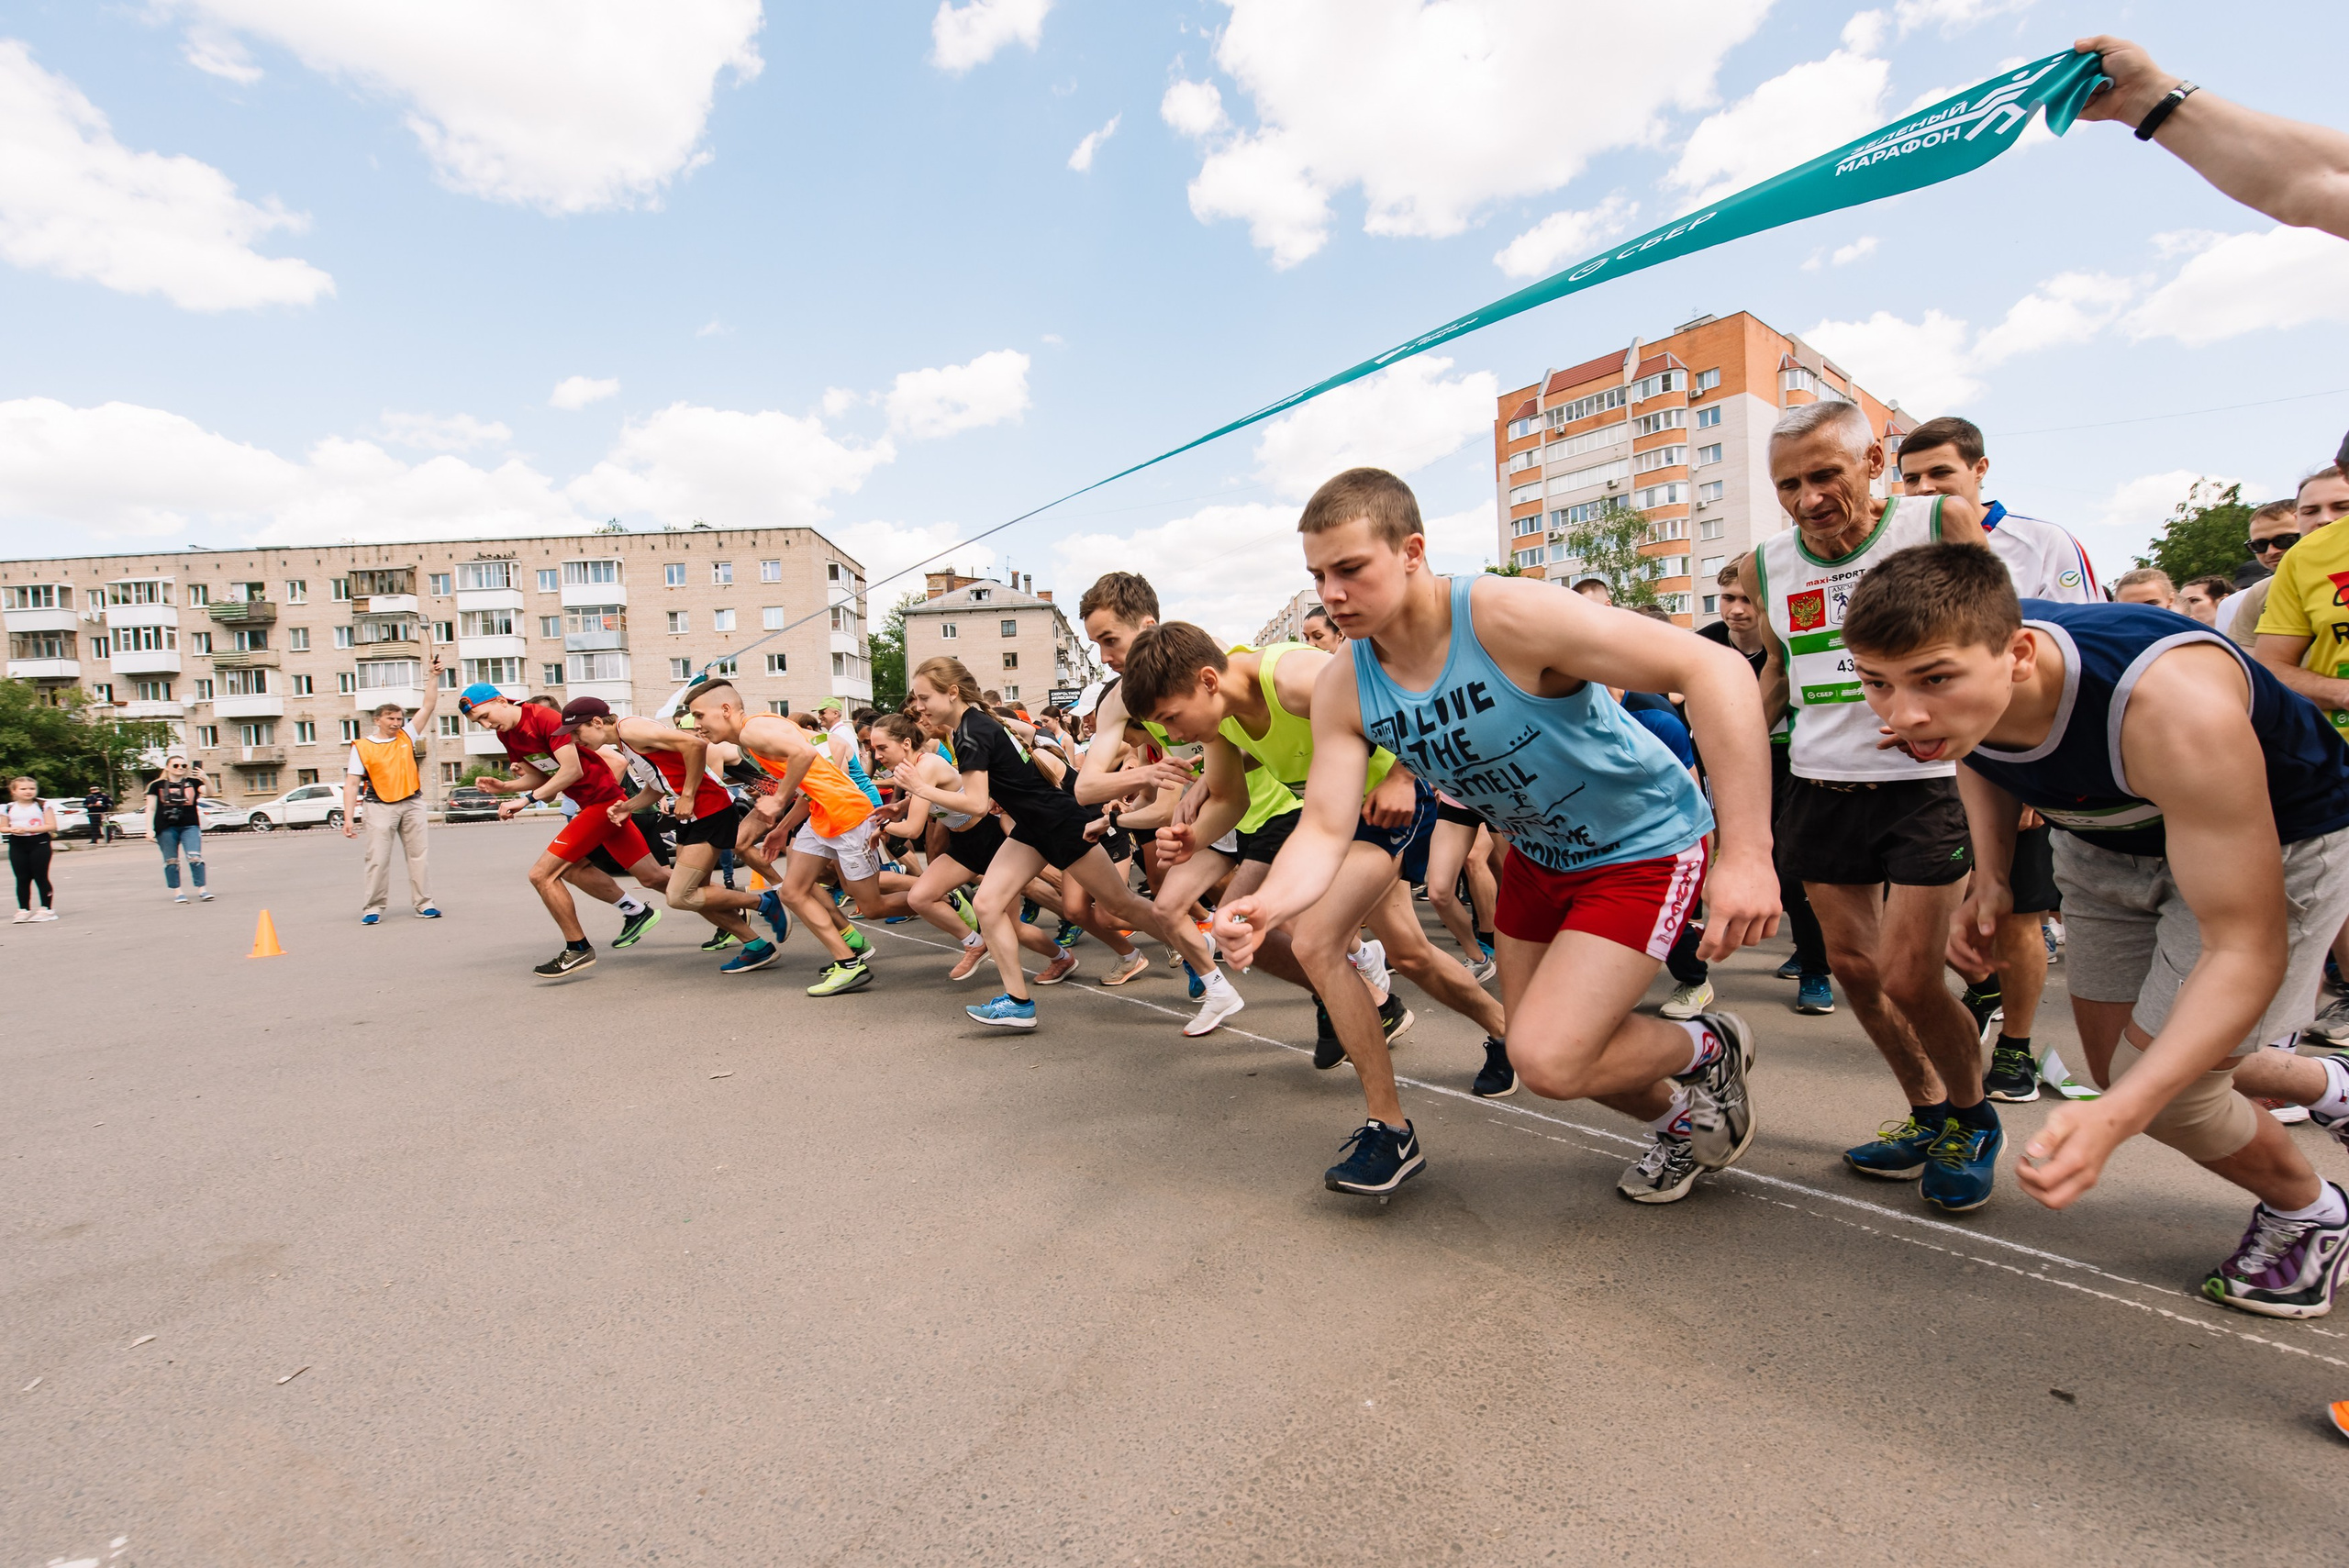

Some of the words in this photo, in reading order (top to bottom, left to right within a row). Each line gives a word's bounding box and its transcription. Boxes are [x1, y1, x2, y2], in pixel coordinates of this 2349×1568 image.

[1835, 126, 1962, 176] МАРАФОН
[1851, 100, 1968, 155] ЗЕЛЕНЫЙ
[1616, 212, 1718, 260] СБЕР
[1407, 727, 1481, 771] THE
[1438, 762, 1539, 798] SMELL
